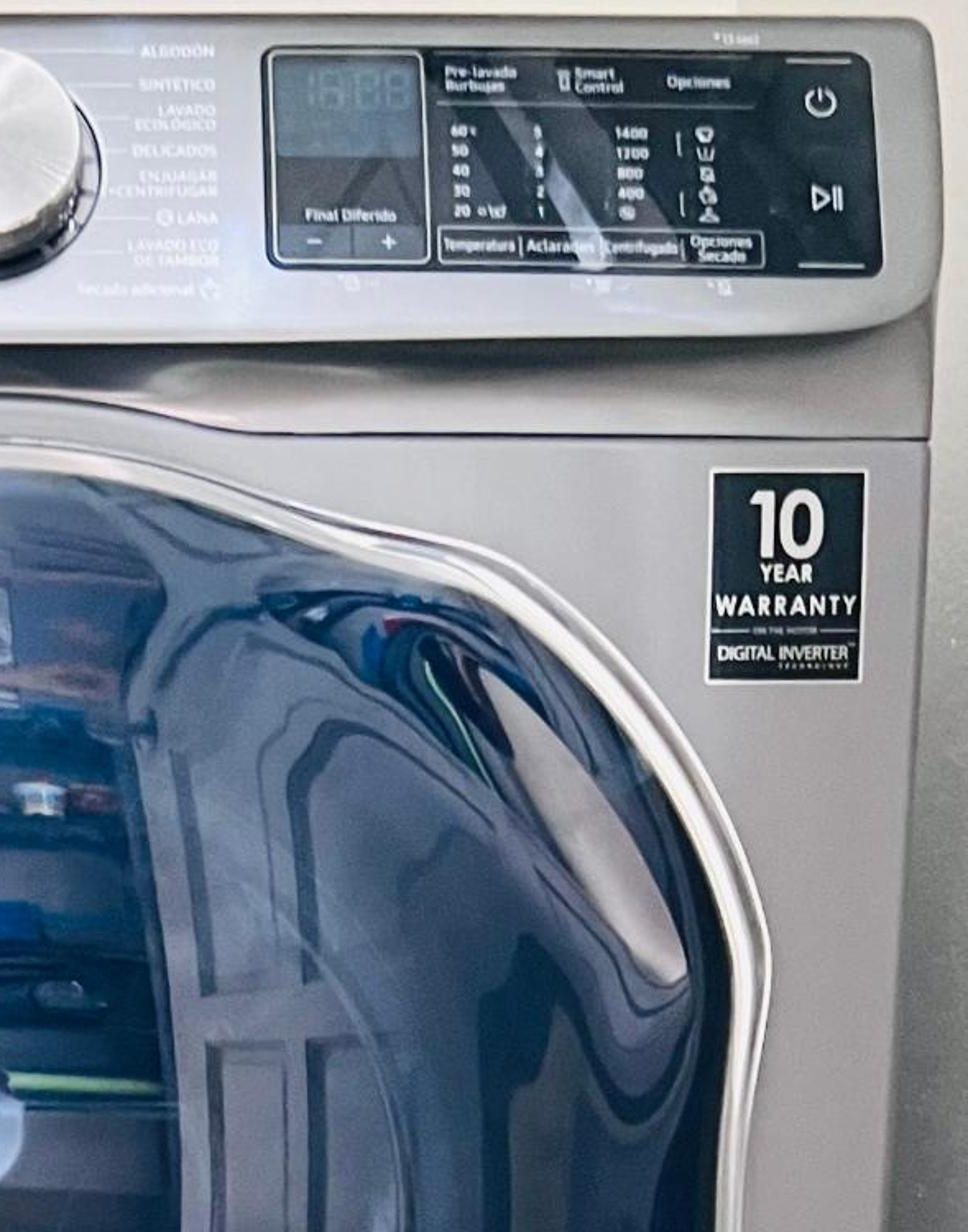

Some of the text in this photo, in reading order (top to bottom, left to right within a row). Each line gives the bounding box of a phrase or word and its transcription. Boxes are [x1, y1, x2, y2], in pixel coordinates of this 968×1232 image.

[140, 43, 215, 58] ALGODÓN
[575, 67, 616, 80] Smart
[138, 77, 215, 92] SINTÉTICO
[444, 79, 505, 94] Burbujas
[575, 80, 624, 94] Control
[666, 74, 731, 91] Opciones
[158, 104, 216, 117] LAVADO
[134, 117, 216, 132] ECOLÓGICO
[615, 125, 648, 140] 1400
[131, 143, 217, 158] DELICADOS
[452, 163, 471, 178] 40
[177, 210, 219, 225] LANA
[305, 208, 398, 223] Final Diferido
[126, 238, 186, 252] LAVADO
[443, 237, 516, 253] Temperatura
[689, 235, 753, 251] Opciones
[697, 250, 748, 264] Secado
[749, 488, 825, 559] 10
[760, 563, 812, 584] YEAR
[715, 594, 857, 617] WARRANTY
[717, 644, 849, 662] DIGITAL INVERTER
